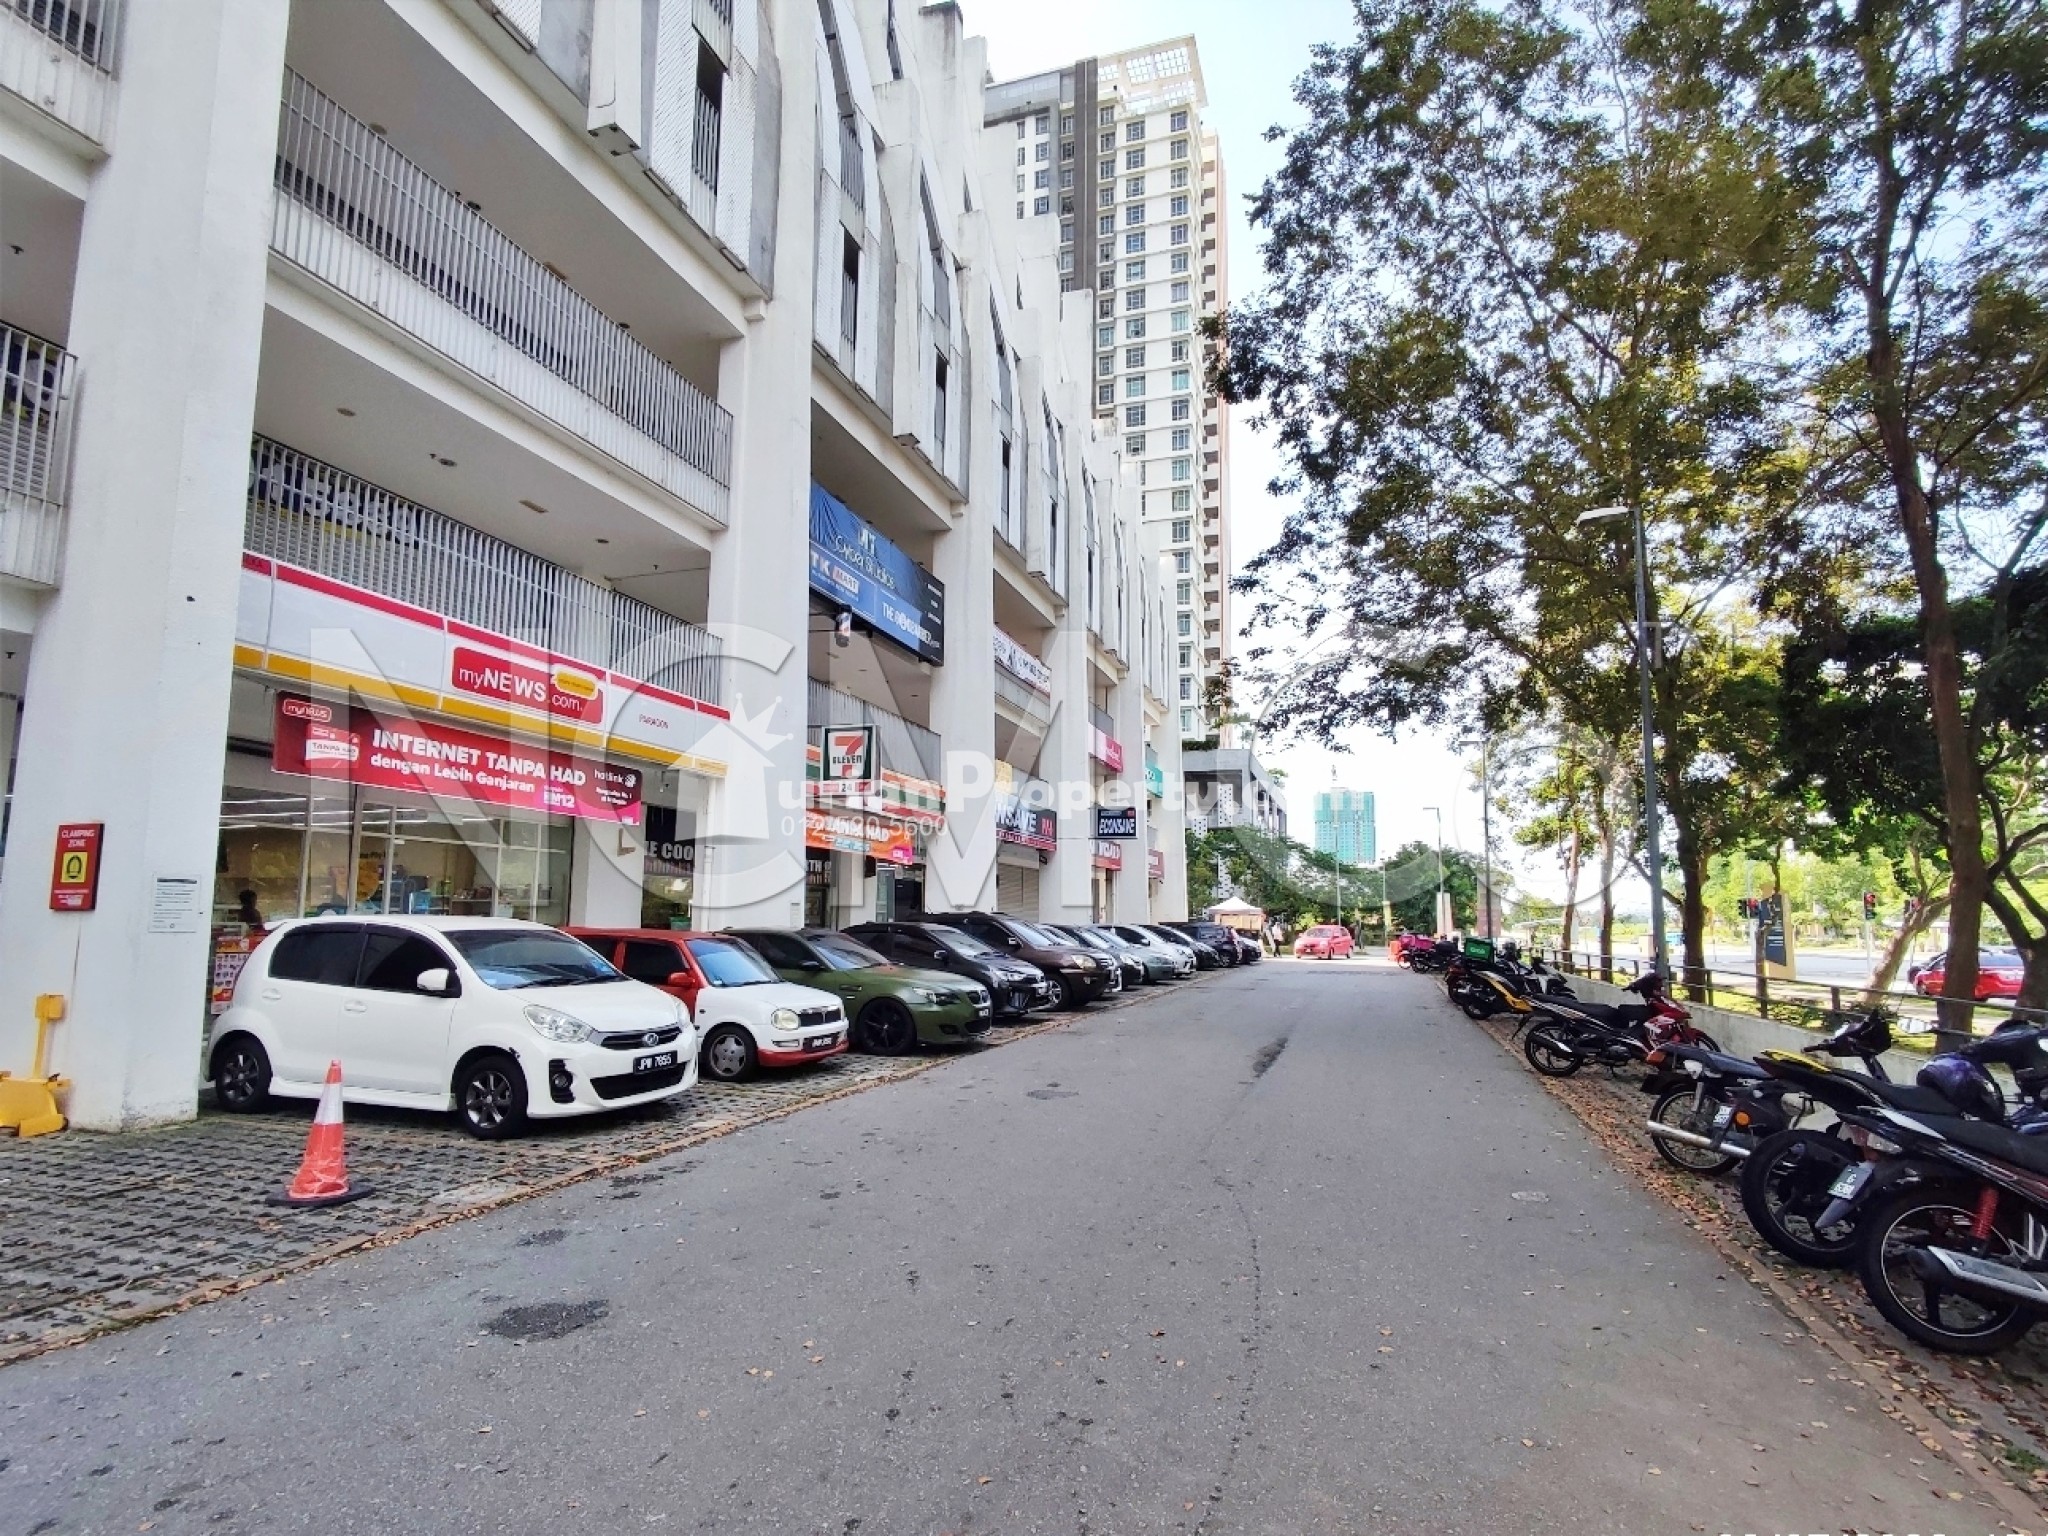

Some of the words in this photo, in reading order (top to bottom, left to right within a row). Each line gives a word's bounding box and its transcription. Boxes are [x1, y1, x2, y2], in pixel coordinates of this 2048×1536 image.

[459, 668, 546, 701] myNEWS
[370, 753, 431, 775] dengan
[434, 763, 473, 782] Lebih
[476, 771, 535, 793] Ganjaran
[372, 729, 481, 766] INTERNET
[485, 751, 546, 779] TANPA
[550, 765, 586, 786] HAD
[594, 769, 623, 784] hotlink
[62, 830, 95, 839] CLAMPING
